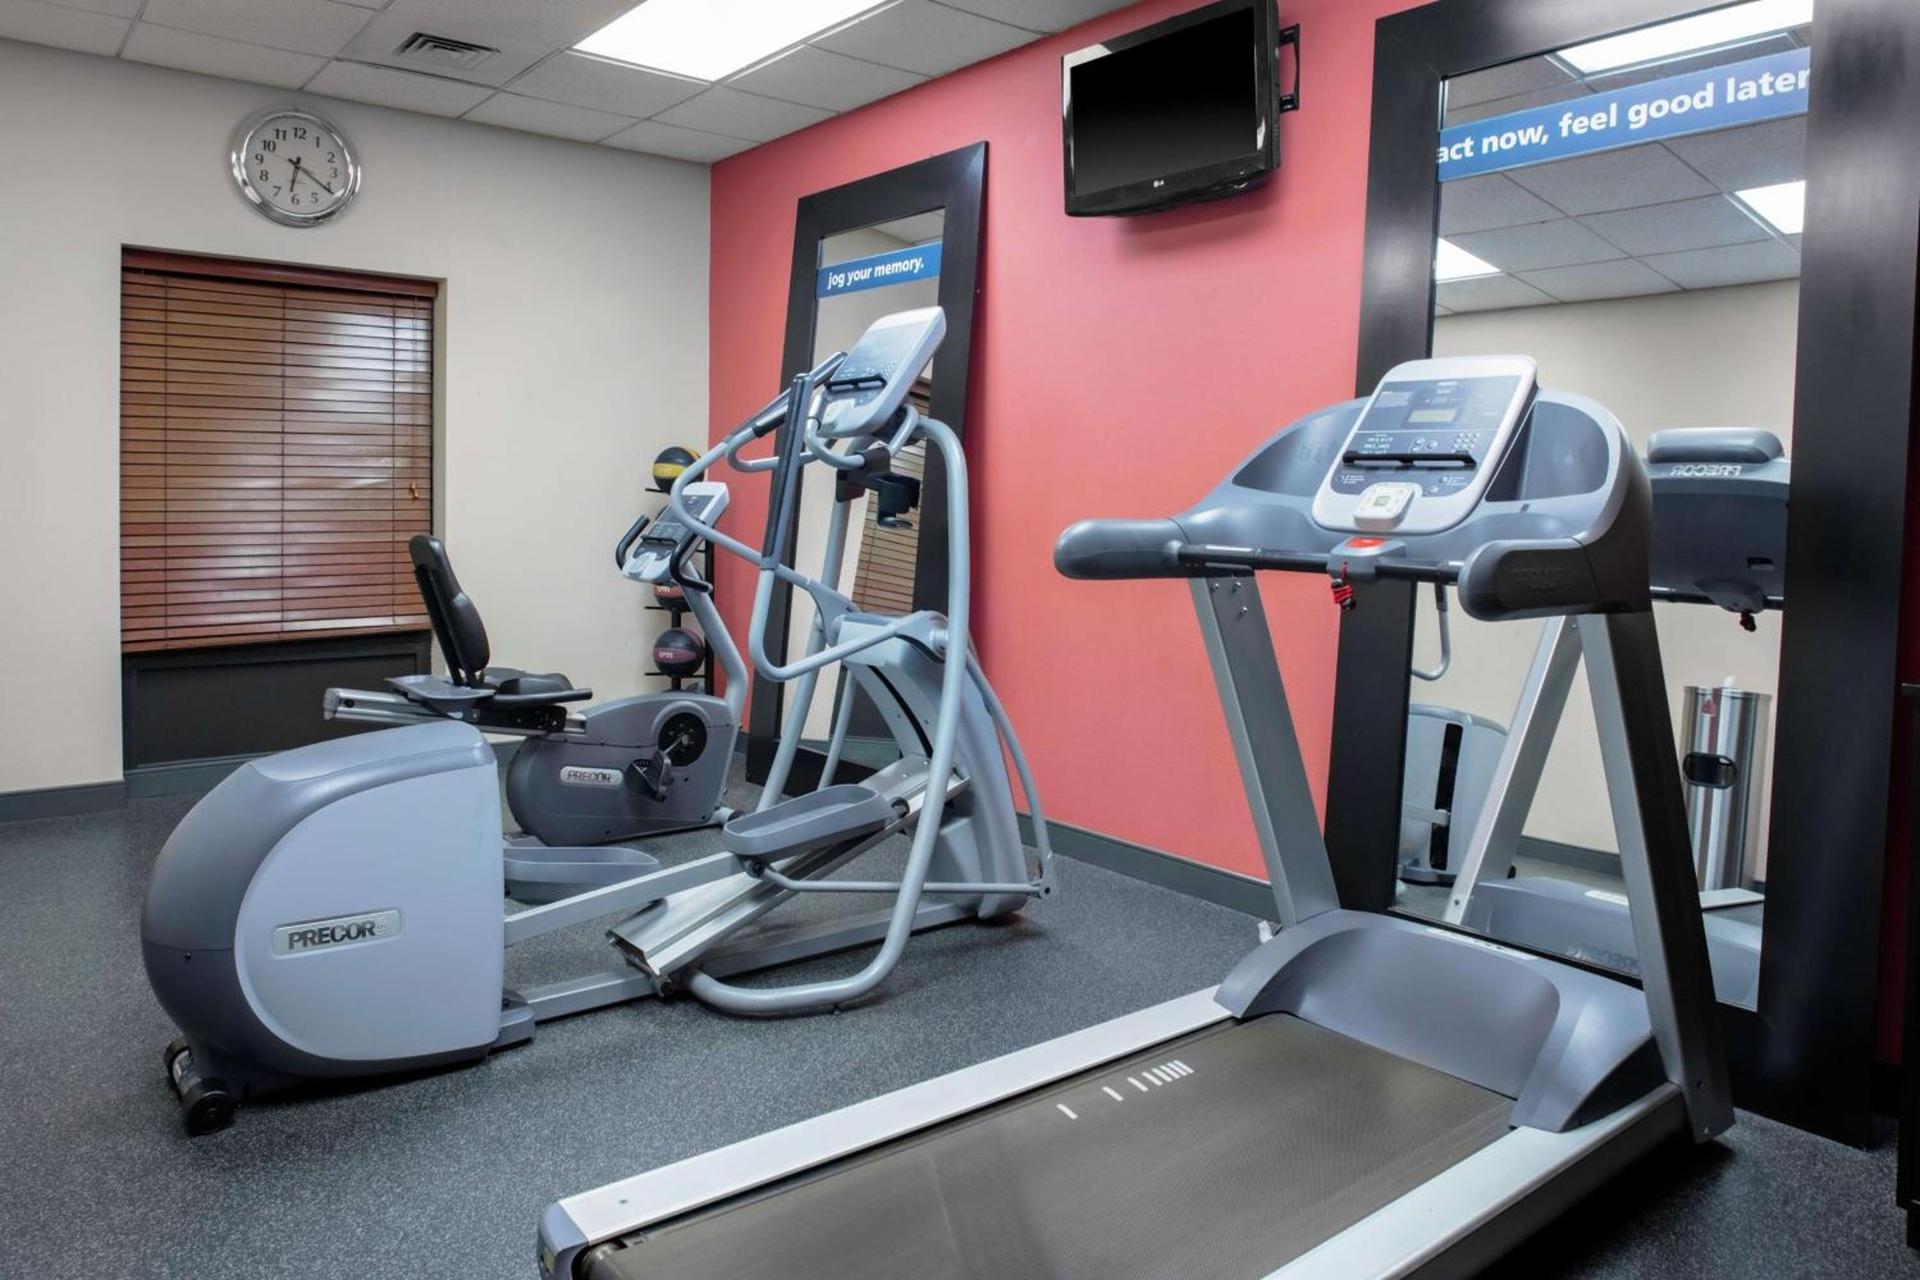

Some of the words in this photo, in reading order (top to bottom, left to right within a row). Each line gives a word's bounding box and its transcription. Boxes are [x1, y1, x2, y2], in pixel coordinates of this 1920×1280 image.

[1436, 136, 1474, 164] act
[1481, 125, 1549, 154] now,
[1559, 103, 1617, 138] feel
[1628, 82, 1715, 130] good
[1726, 68, 1810, 104] later
[274, 128, 287, 141] 11
[292, 127, 307, 140] 12
[262, 139, 277, 152] 10
[315, 136, 321, 148] 1
[255, 153, 264, 165] 9
[327, 151, 335, 163] 2
[259, 169, 269, 181] 8
[330, 167, 338, 178] 3
[273, 186, 282, 197] 7
[311, 192, 319, 203] 5
[291, 194, 300, 205] 6
[827, 272, 845, 290] jog
[847, 267, 873, 286] your
[874, 257, 924, 274] memory.
[288, 920, 376, 950] PRECOR
